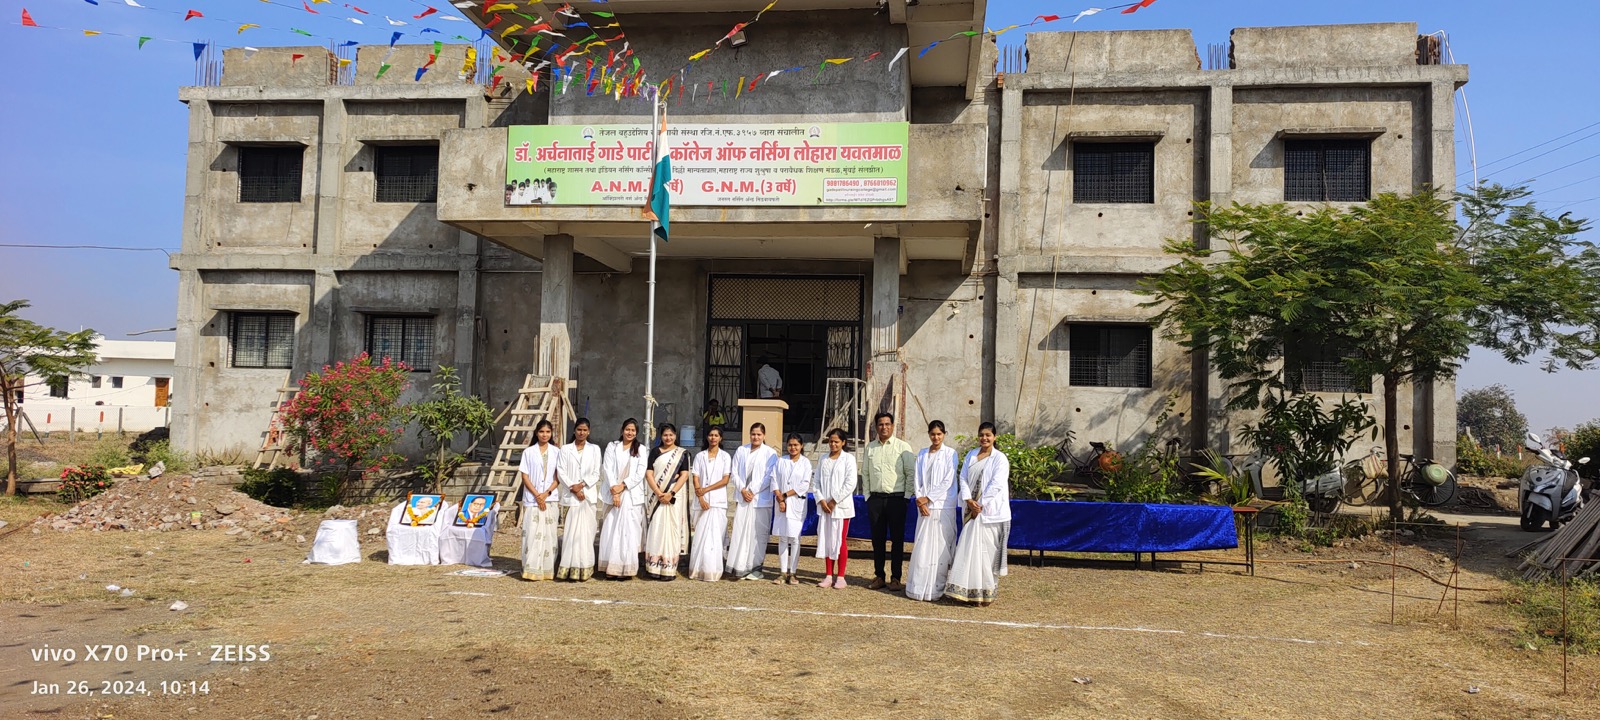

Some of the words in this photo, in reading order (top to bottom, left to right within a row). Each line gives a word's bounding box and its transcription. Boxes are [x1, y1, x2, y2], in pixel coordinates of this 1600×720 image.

[515, 143, 532, 161] डॉ.
[536, 141, 596, 163] अर्चनाताई
[598, 141, 624, 161] गाडे
[627, 141, 657, 161] पाटी
[670, 141, 713, 161] कॉलेज
[716, 142, 747, 161] ऑफ
[750, 140, 791, 161] नर्सिंग
[794, 140, 838, 163] लोहारा
[840, 145, 902, 161] यवतमाळ
